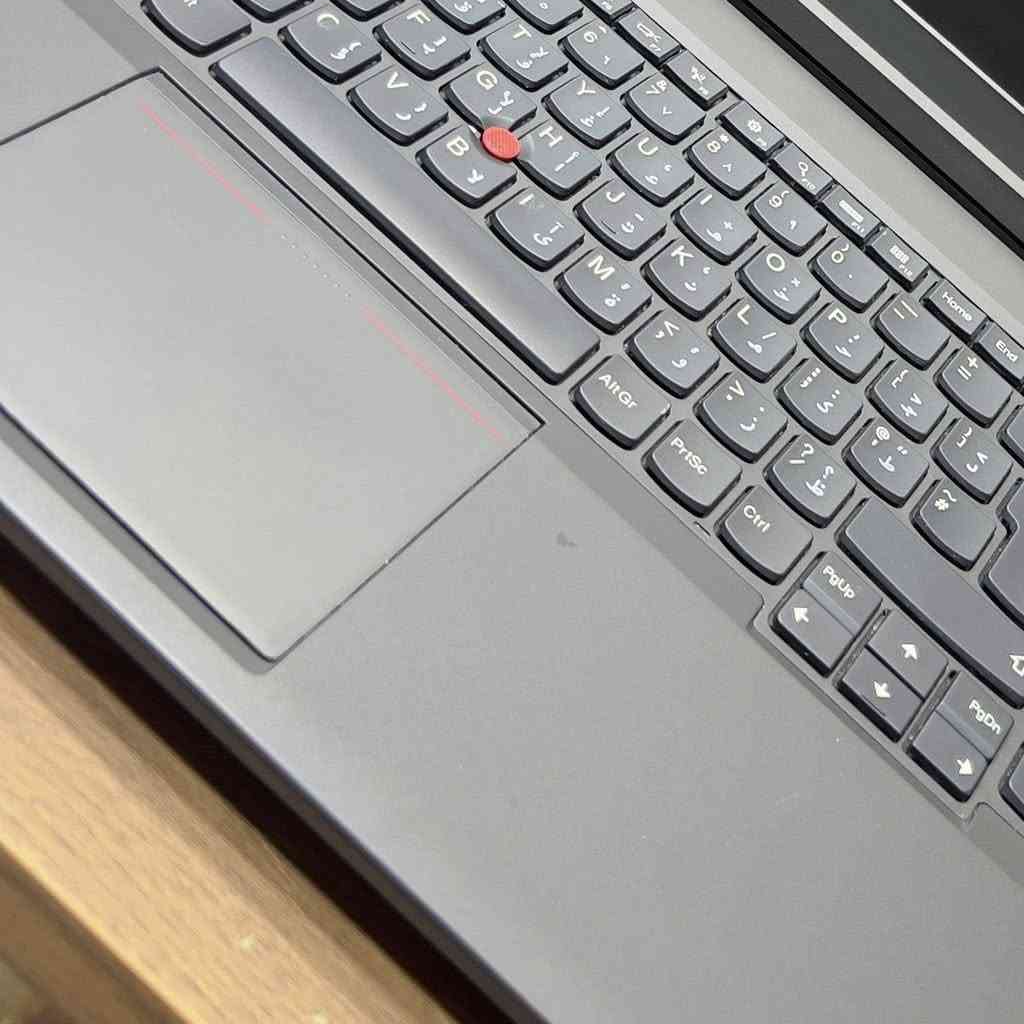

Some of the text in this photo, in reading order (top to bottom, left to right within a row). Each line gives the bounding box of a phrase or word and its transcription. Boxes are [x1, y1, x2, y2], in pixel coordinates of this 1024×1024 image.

[316, 12, 340, 25] C
[406, 9, 431, 25] F
[512, 23, 532, 39] T
[581, 29, 598, 43] 6
[386, 71, 409, 89] V
[476, 69, 498, 91] G
[575, 79, 597, 96] Y
[446, 135, 470, 157] B
[538, 125, 564, 148] H
[637, 137, 659, 156] U
[706, 138, 721, 153] 8
[605, 191, 626, 203] J
[768, 193, 785, 208] 9
[670, 245, 695, 267] K
[765, 252, 786, 272] O
[587, 254, 616, 281] M
[736, 303, 751, 325] L
[827, 307, 848, 324] P
[941, 289, 975, 322] Home
[995, 338, 1020, 363] End
[598, 374, 638, 409] AltGr
[873, 426, 891, 442] @
[668, 436, 708, 478] PrtSc
[800, 442, 815, 458] ?
[743, 504, 771, 533] Ctrl
[822, 563, 855, 599] PgUp
[968, 699, 1001, 735] PgDn
